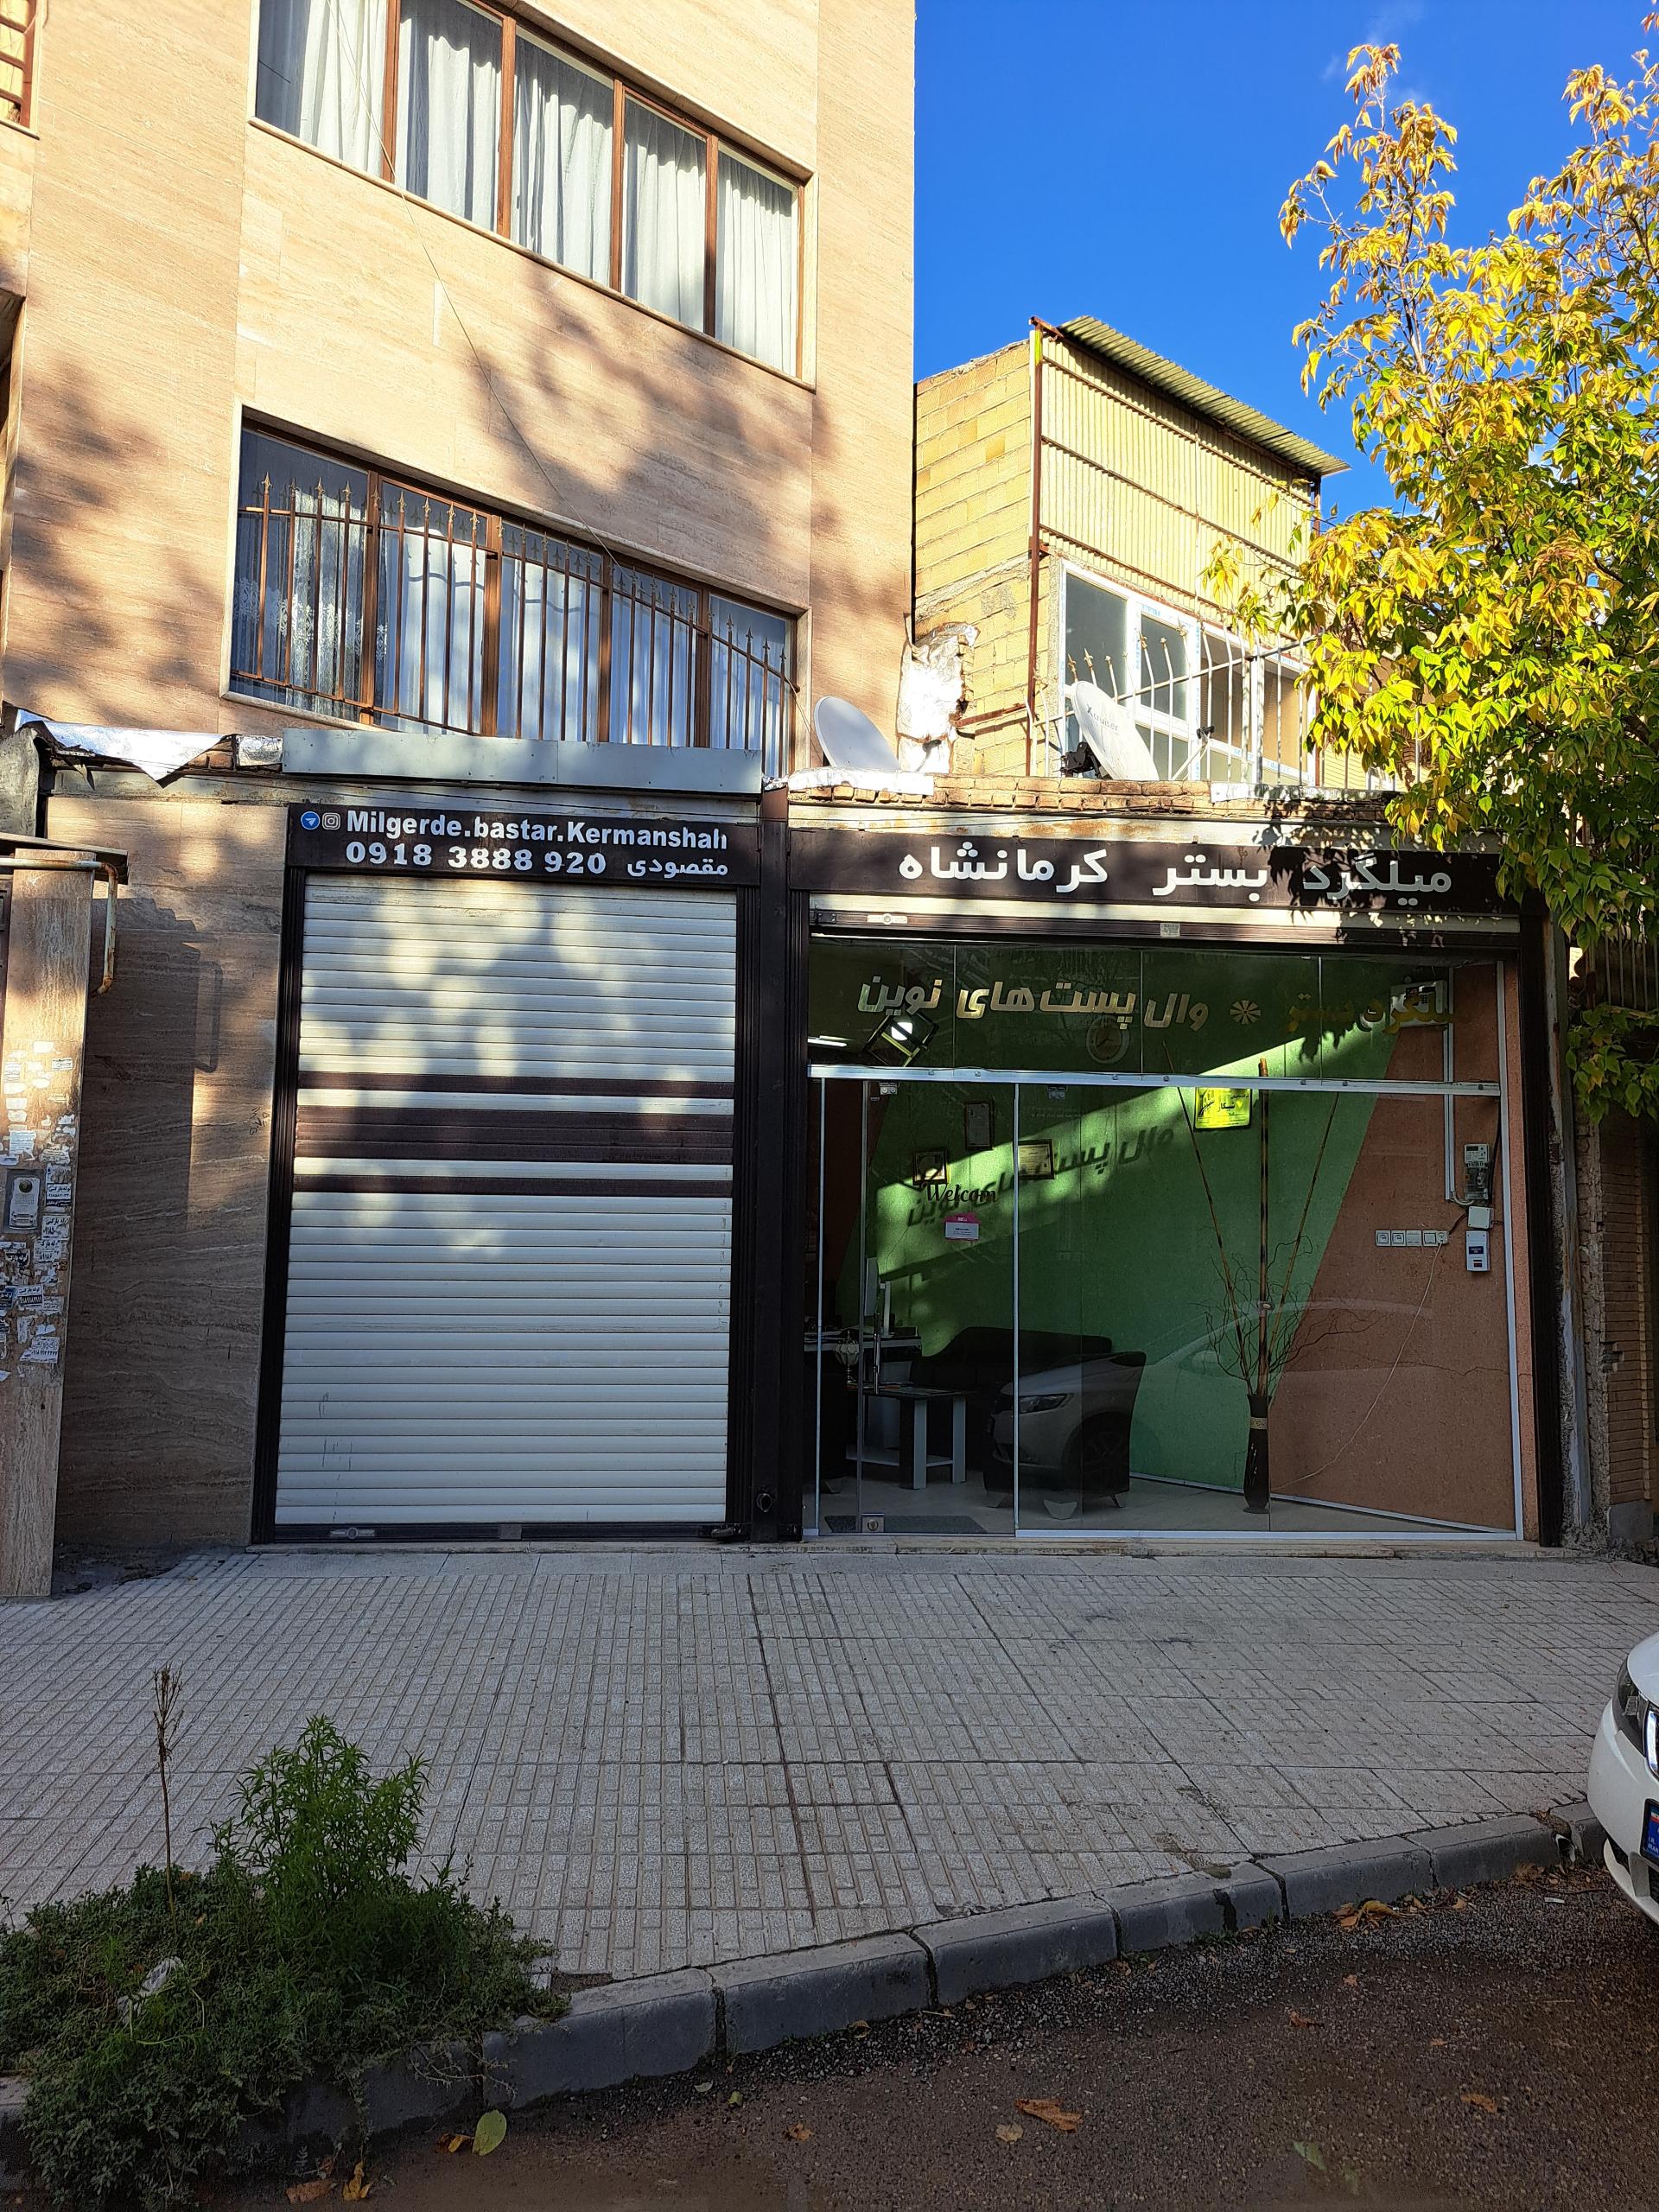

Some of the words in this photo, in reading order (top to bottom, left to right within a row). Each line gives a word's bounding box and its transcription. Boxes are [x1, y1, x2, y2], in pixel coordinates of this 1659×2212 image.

[346, 841, 432, 866] 0918
[448, 845, 534, 871] 3888
[543, 851, 607, 874] 920
[627, 858, 729, 879] مقصودی
[899, 841, 1109, 893] کرمانشاه
[1152, 853, 1268, 903] بستر
[1303, 851, 1453, 907] میلگرد
[857, 976, 943, 1017] نوین
[1143, 992, 1210, 1032] وال
